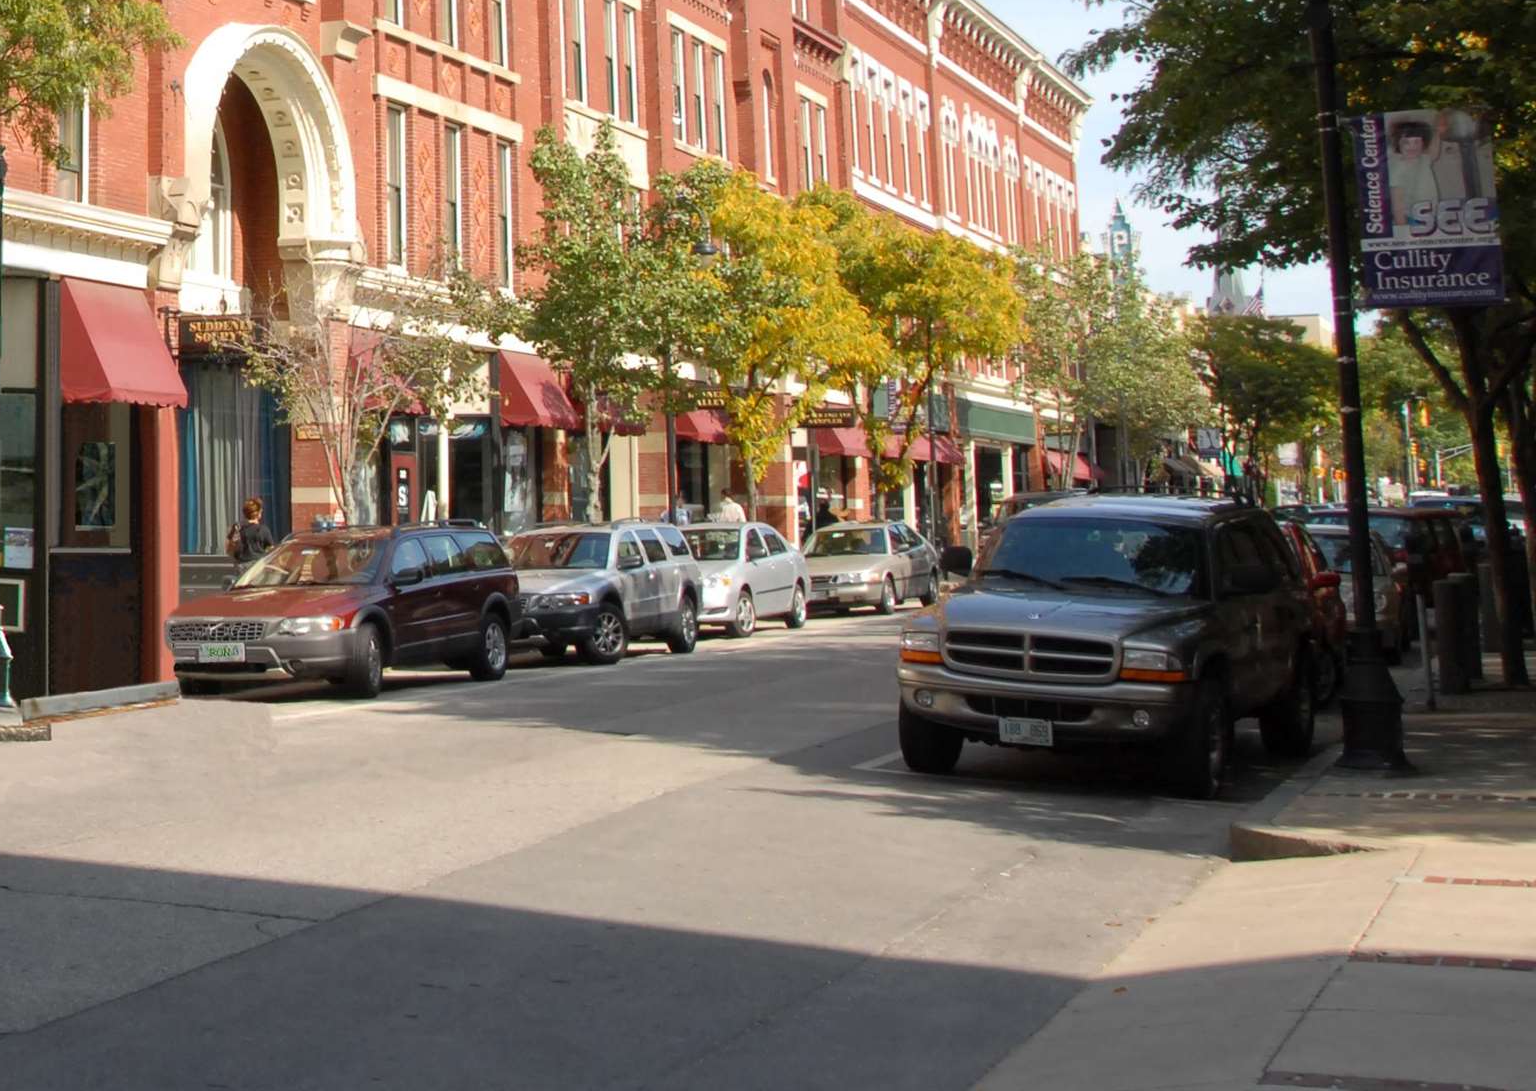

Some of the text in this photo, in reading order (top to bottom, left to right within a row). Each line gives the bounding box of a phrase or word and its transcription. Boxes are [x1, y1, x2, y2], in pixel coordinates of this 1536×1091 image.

[1360, 114, 1384, 234] Science Center
[1410, 197, 1490, 236] SEE
[1374, 249, 1452, 273] Cullity
[1376, 271, 1490, 290] Insurance
